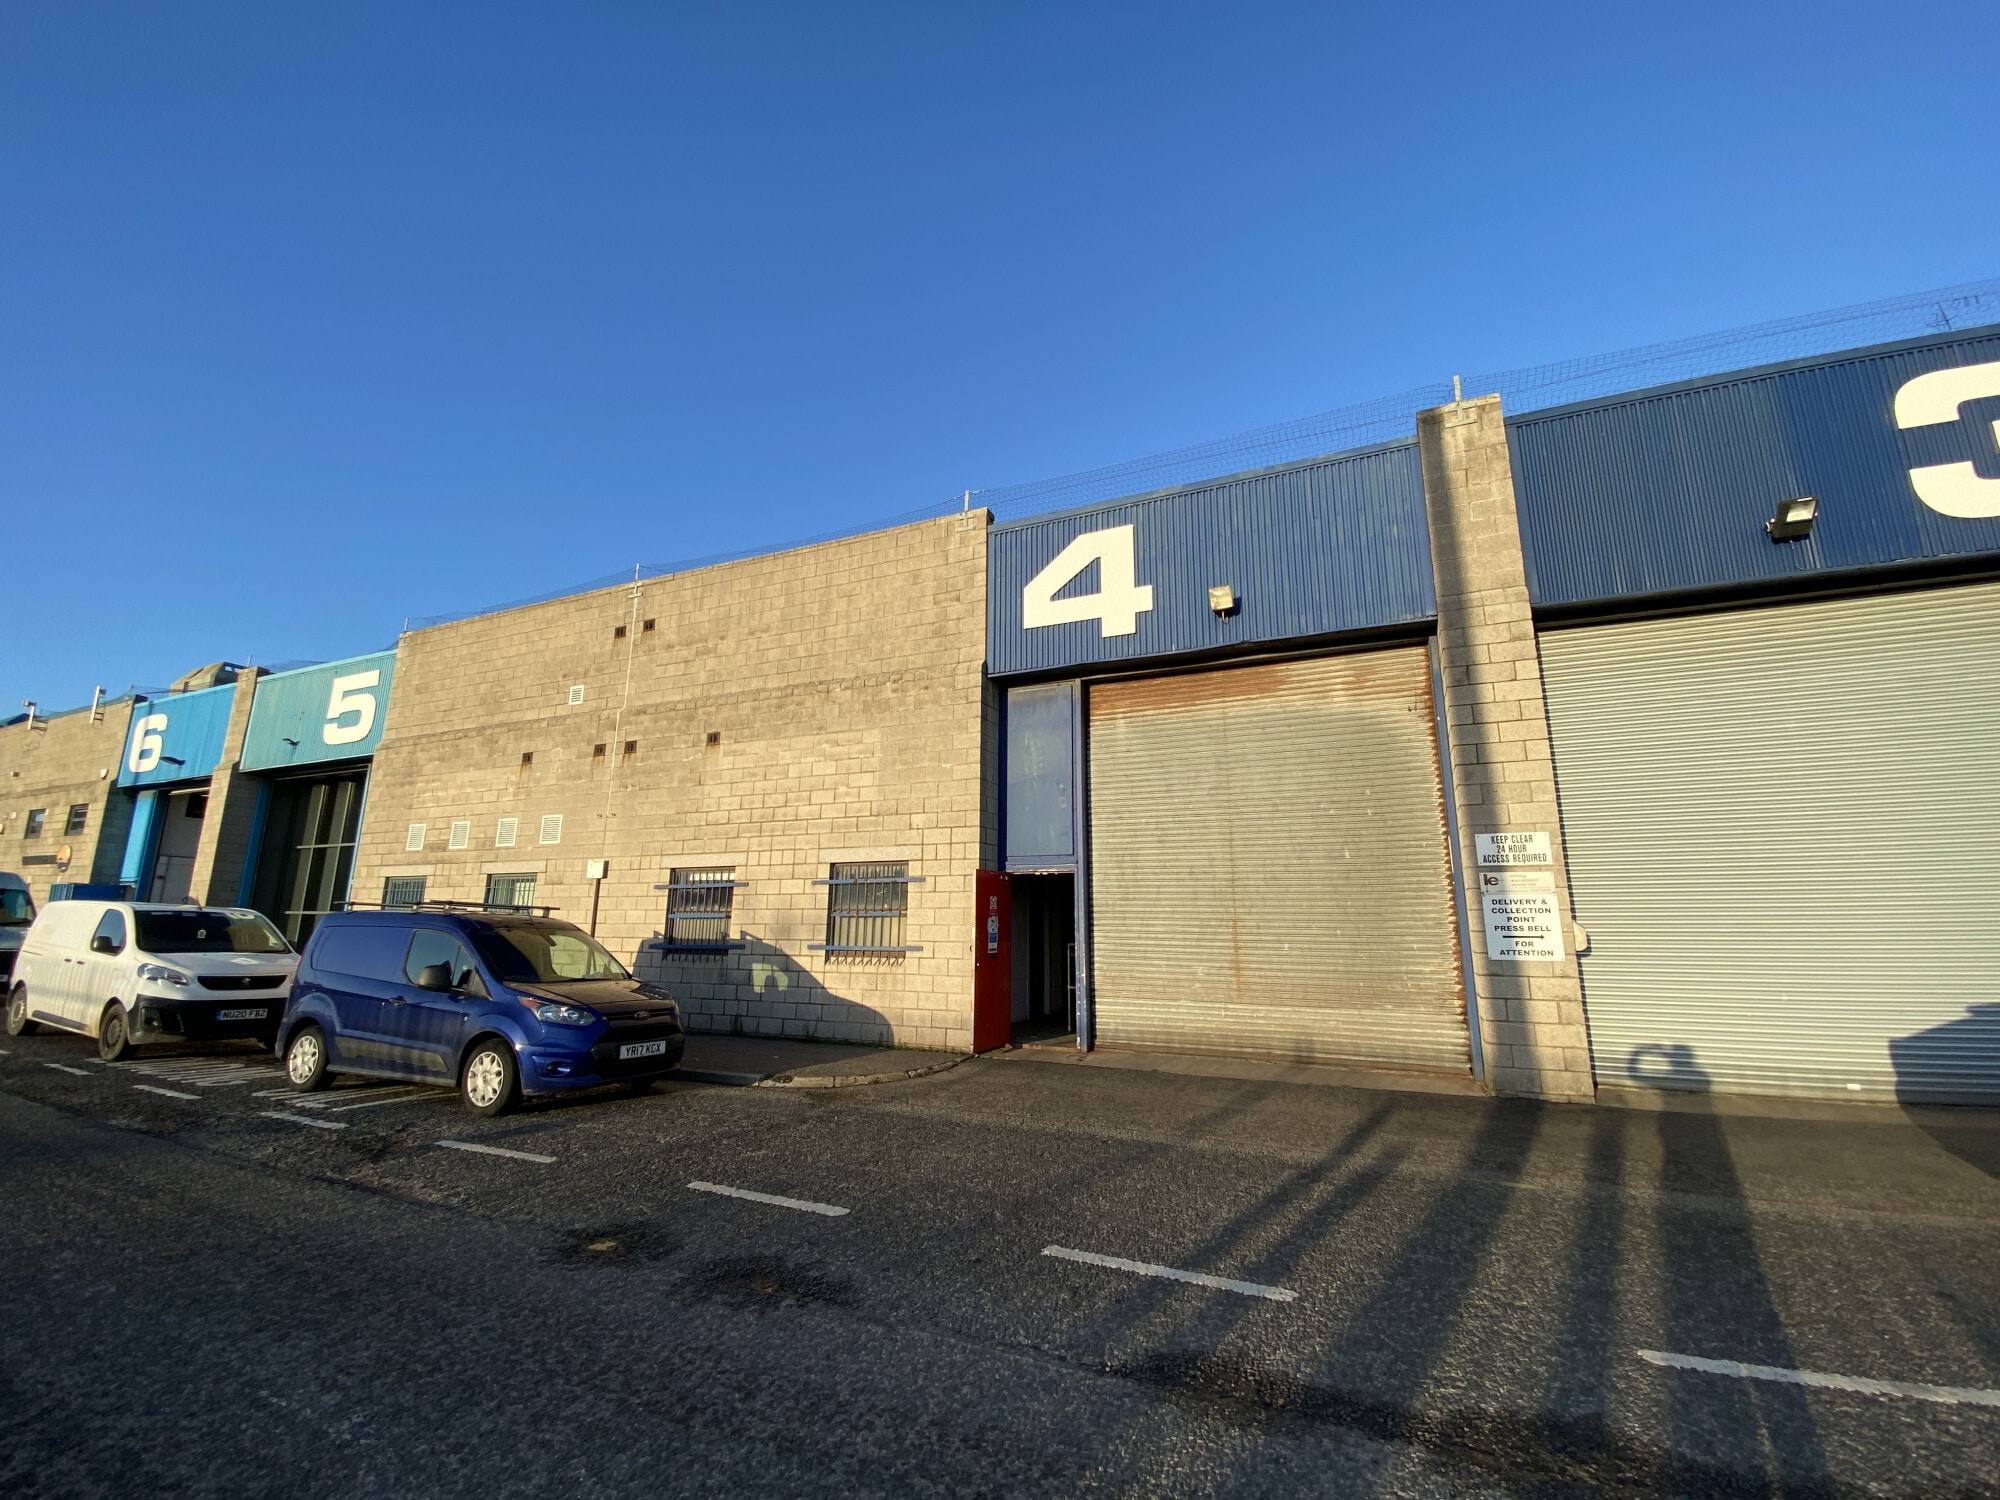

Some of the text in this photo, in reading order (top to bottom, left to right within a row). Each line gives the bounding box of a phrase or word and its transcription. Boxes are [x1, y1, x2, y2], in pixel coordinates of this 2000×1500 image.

[1893, 361, 2000, 519] 3
[1023, 524, 1153, 638] 4
[322, 670, 381, 745] 5
[128, 713, 168, 773] 6
[1490, 834, 1533, 845] KEEP CLEAR
[1496, 844, 1527, 854] 24 HOUR
[1482, 853, 1547, 864] ACCESS REQUIRED
[1500, 949, 1554, 957] ATTENTION
[626, 1042, 661, 1057] YR17 KCX
